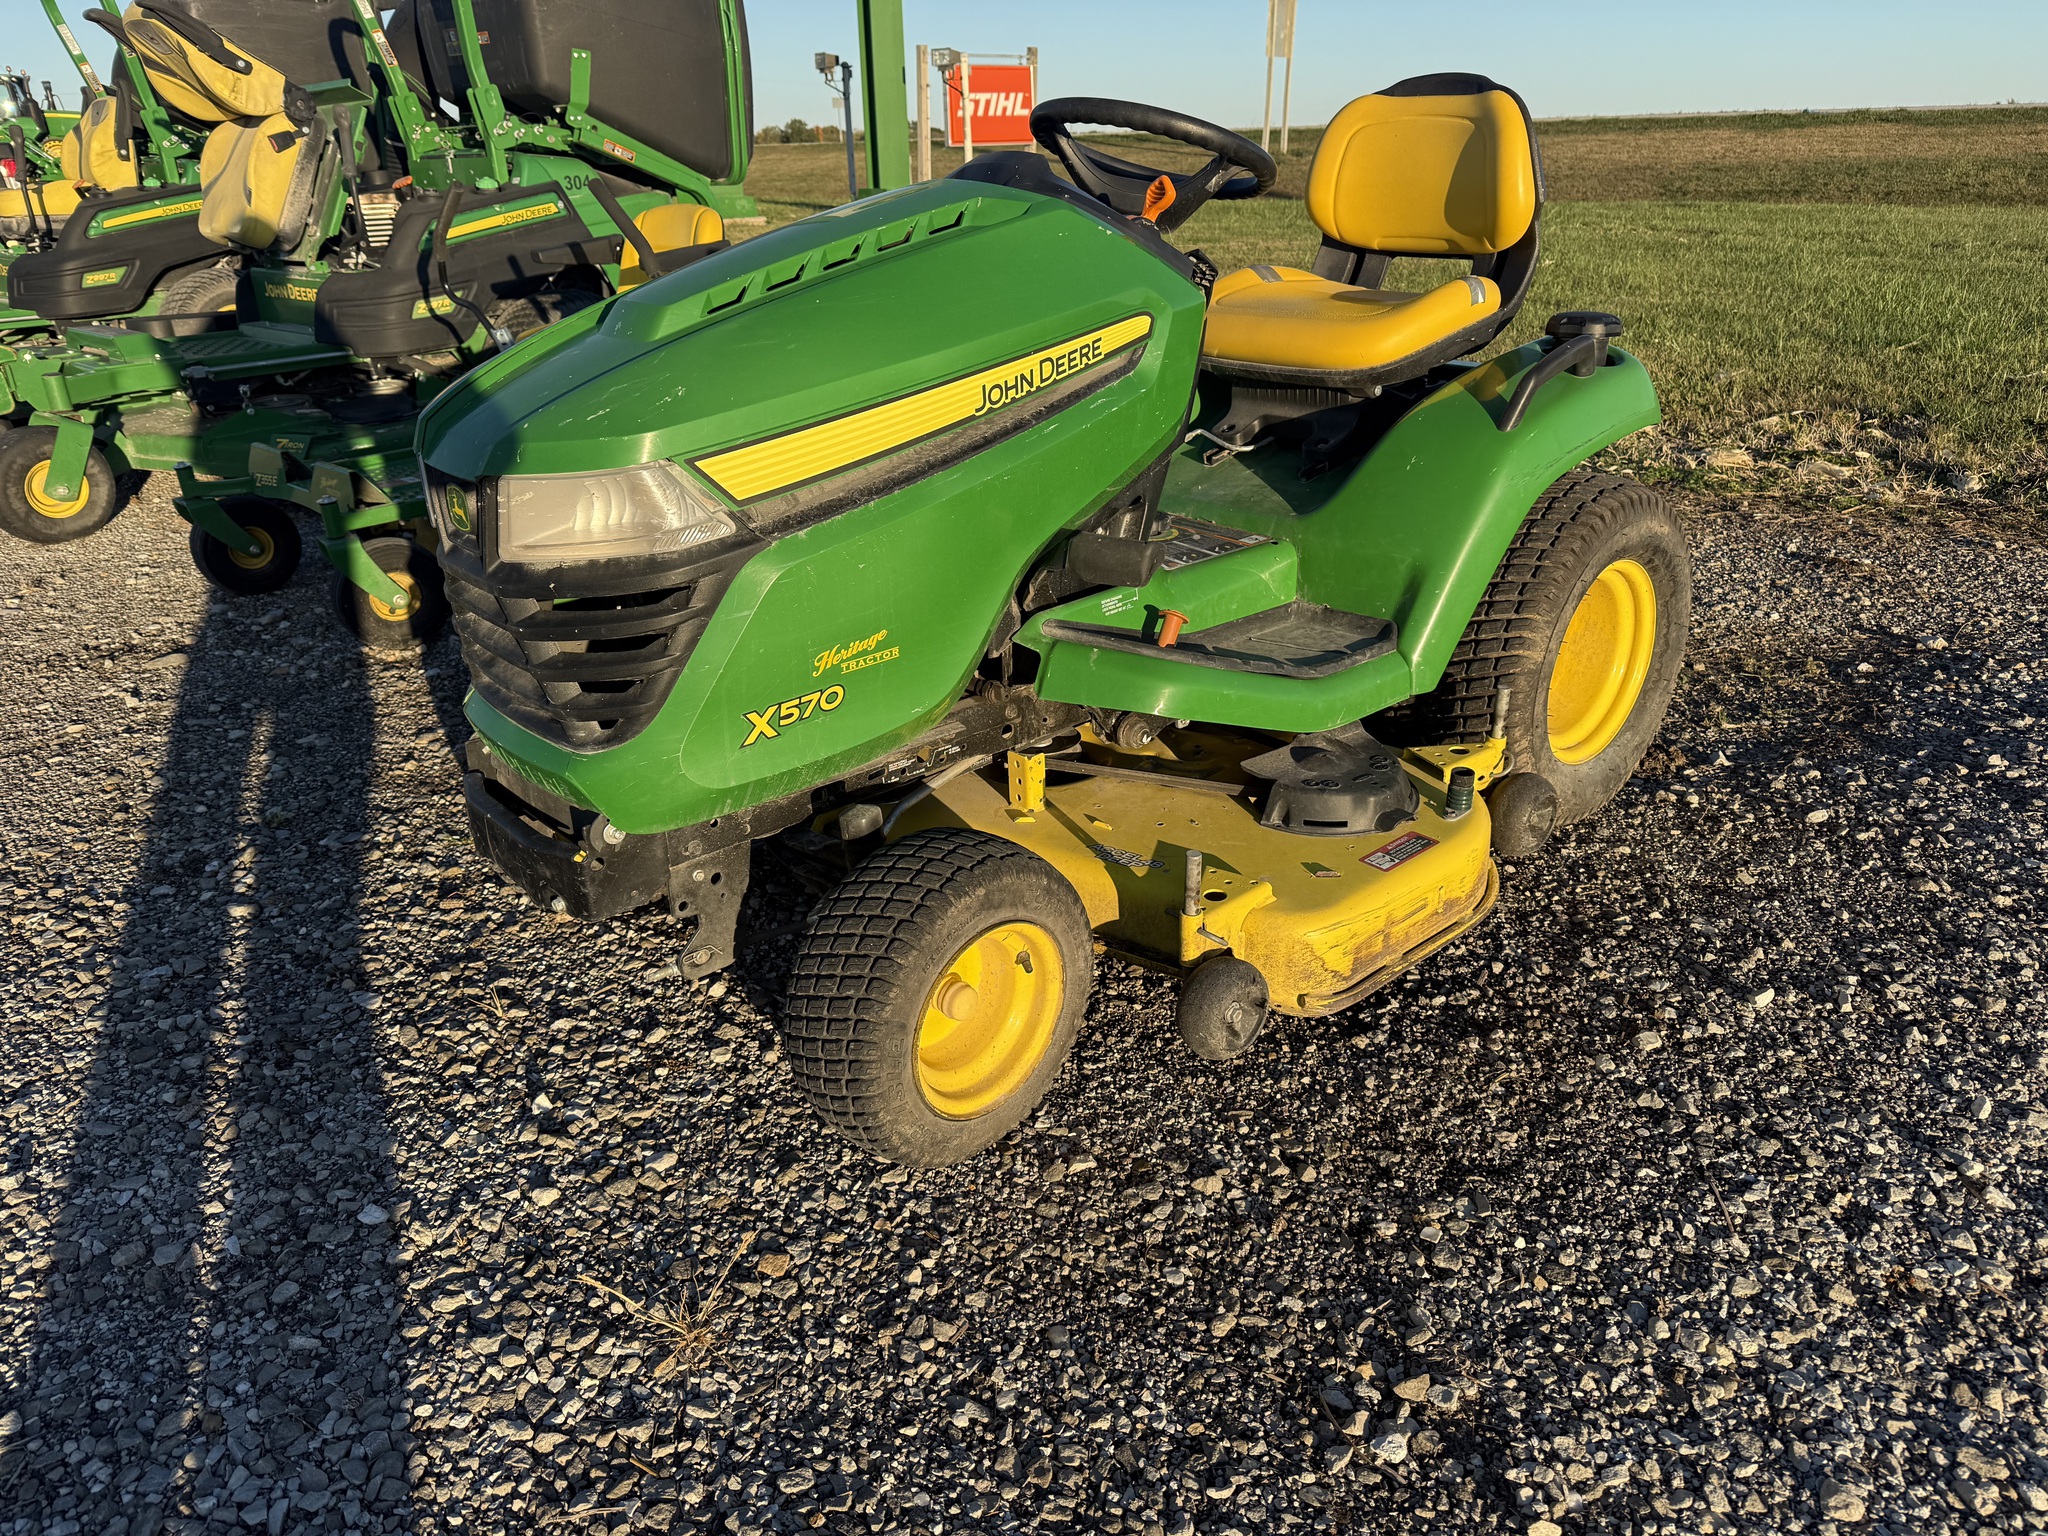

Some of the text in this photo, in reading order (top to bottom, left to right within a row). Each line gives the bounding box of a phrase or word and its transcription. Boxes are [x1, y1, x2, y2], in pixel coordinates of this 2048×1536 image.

[957, 92, 1030, 117] STIHL
[161, 206, 183, 216] JOHN
[502, 205, 553, 224] JOHN DEERE
[264, 281, 288, 299] JOHN
[974, 336, 1104, 414] JOHN DEERE
[812, 629, 888, 677] Heritage
[841, 646, 900, 674] TRACTOR
[739, 683, 846, 749] X570
[1087, 844, 1143, 861] ACCEL
